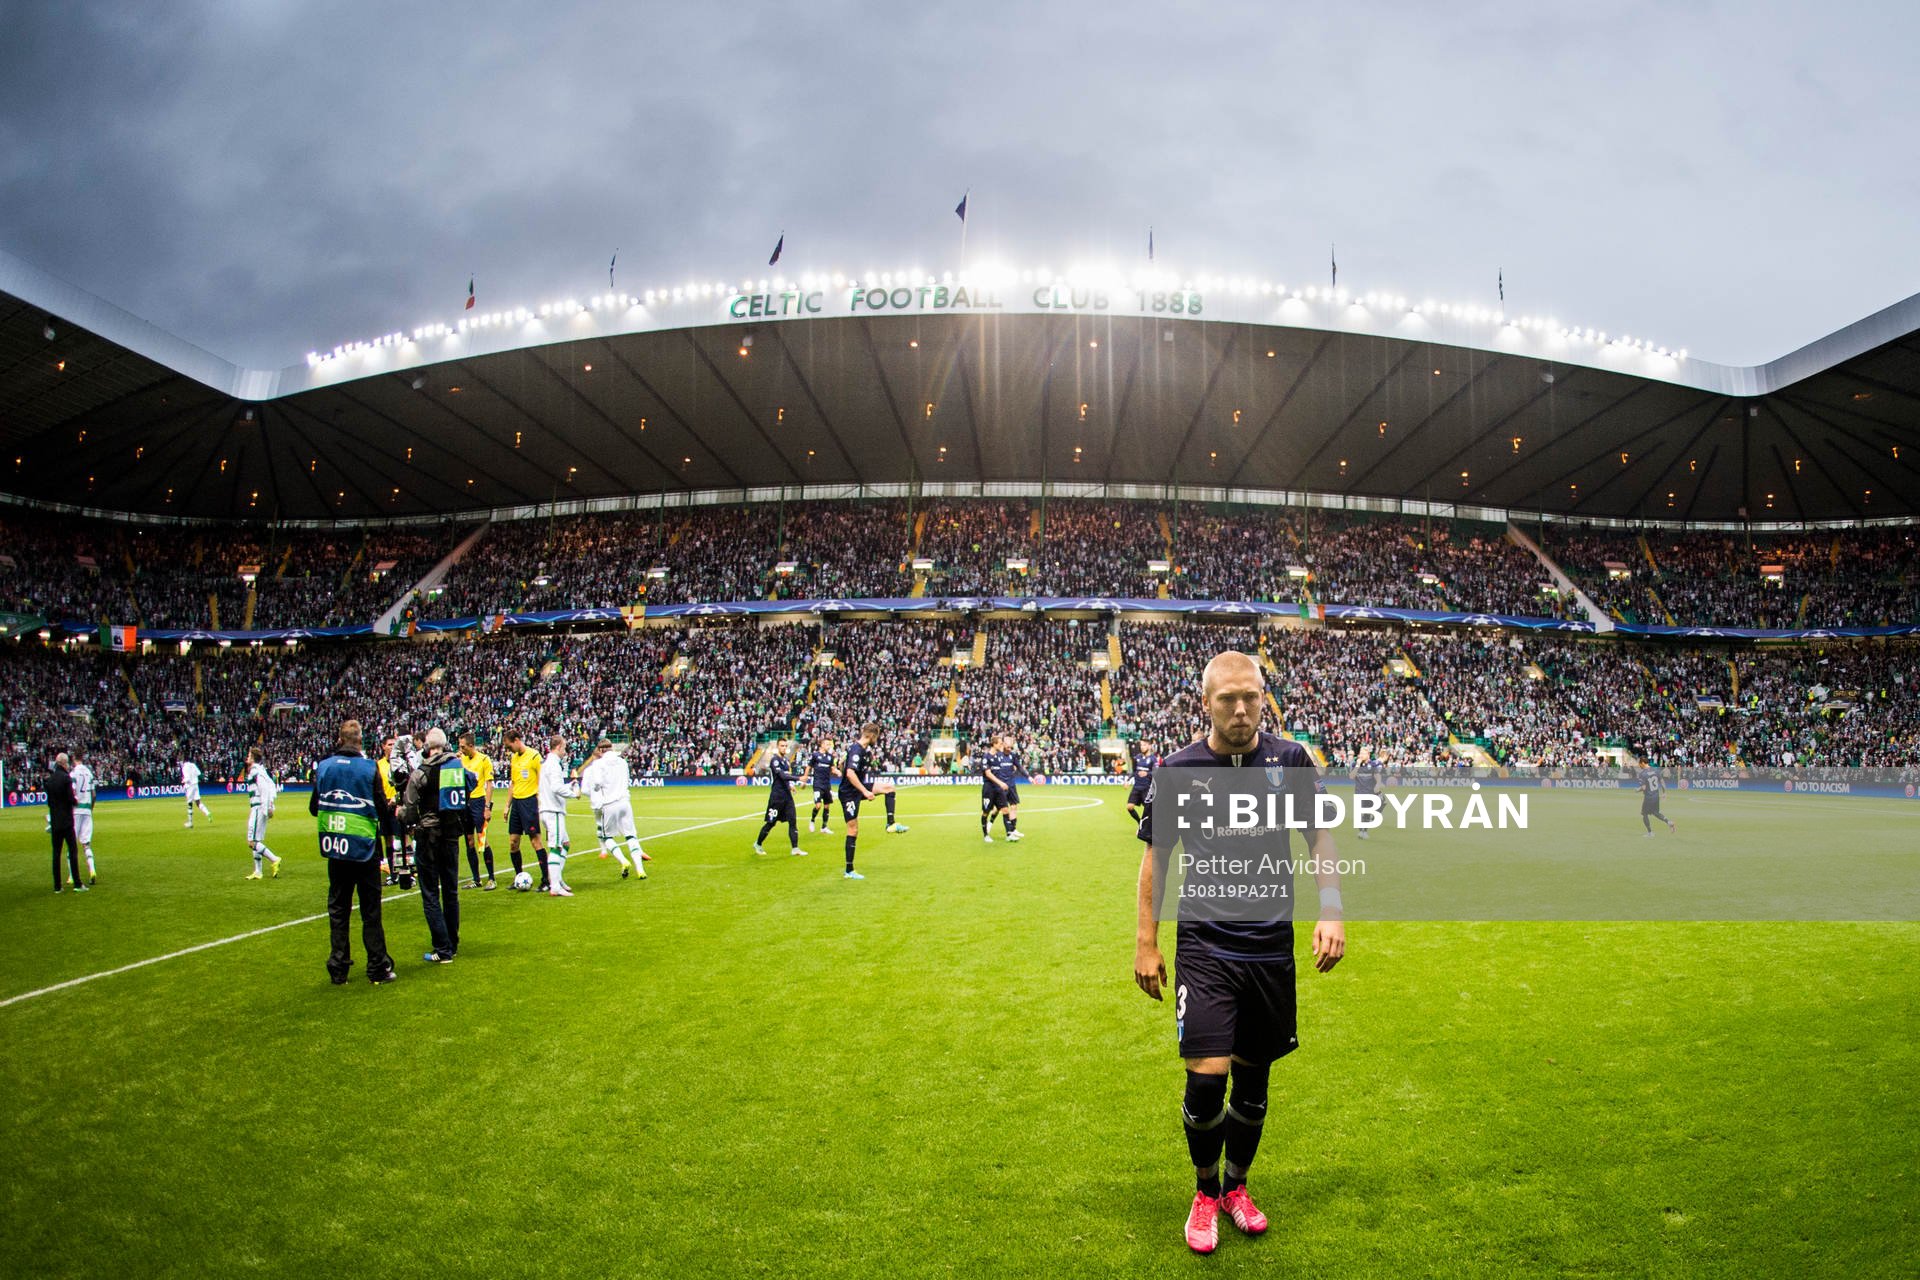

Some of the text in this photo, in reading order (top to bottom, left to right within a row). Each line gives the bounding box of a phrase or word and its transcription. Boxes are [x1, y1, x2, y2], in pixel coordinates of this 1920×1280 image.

[730, 286, 1204, 318] CELTIC FOOTBALL CLUB 1888
[897, 776, 953, 786] CHAMPIONS
[955, 776, 984, 786] LEAG
[1052, 776, 1135, 785] NO TO RACISM
[1402, 778, 1420, 787] NO
[1420, 778, 1436, 786] TO
[1555, 780, 1619, 788] NO TO RACISM
[1693, 779, 1739, 788] NO TO RACISM
[138, 786, 150, 796] NO
[150, 785, 160, 795] TO
[1795, 782, 1850, 793] NO TO RACISM
[22, 791, 48, 803] NO TO
[328, 815, 346, 830] HB
[322, 836, 349, 854] 040
